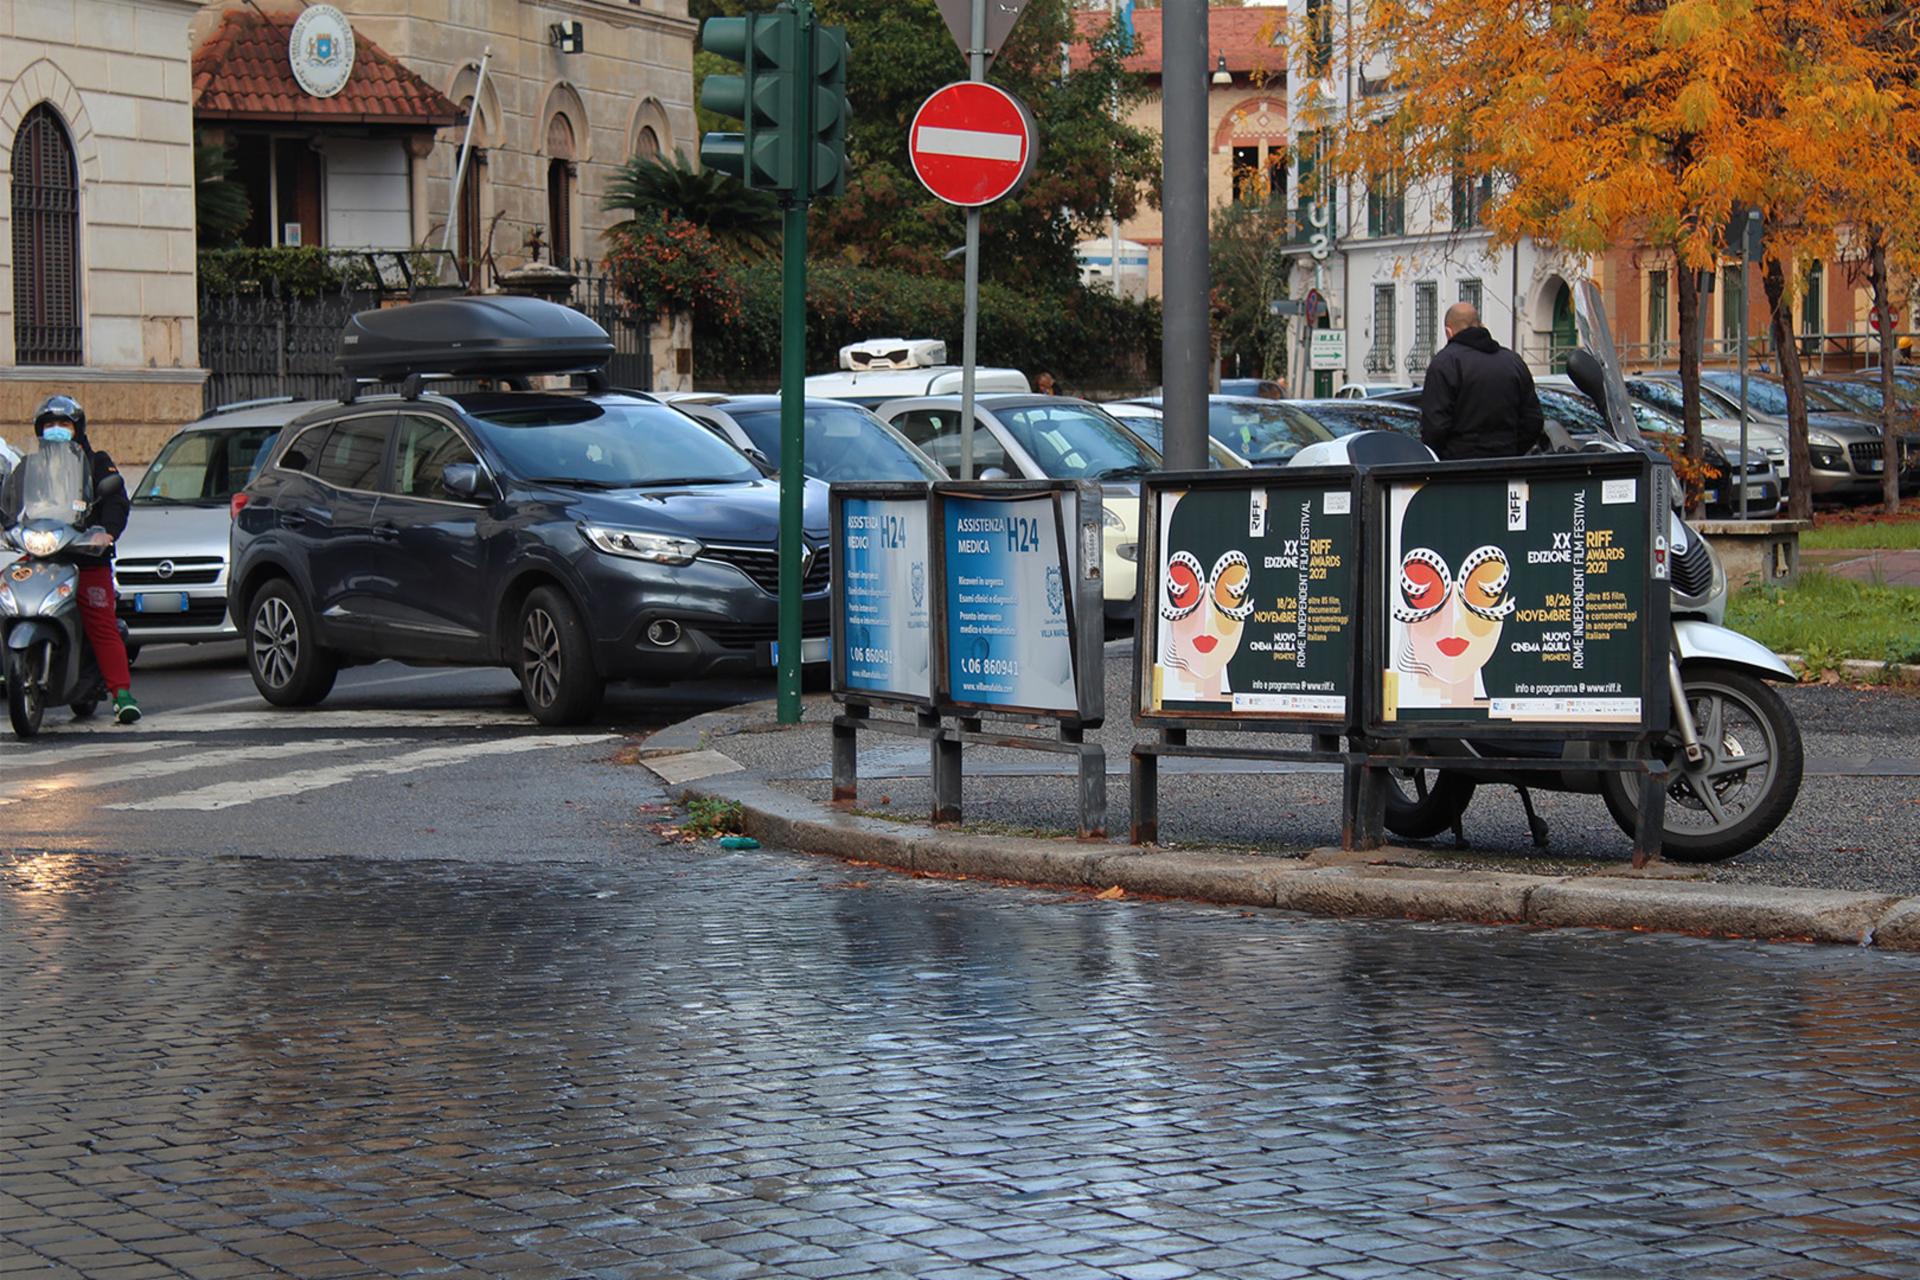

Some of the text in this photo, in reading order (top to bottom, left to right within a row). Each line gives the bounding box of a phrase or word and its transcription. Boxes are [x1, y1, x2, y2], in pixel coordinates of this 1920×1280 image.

[1510, 491, 1521, 523] RIFF
[1252, 500, 1260, 530] RIFF
[880, 515, 906, 549] H24
[957, 517, 1039, 552] ASSISTENZA H24
[1553, 532, 1571, 549] XX
[1586, 530, 1613, 548] RIFF
[958, 539, 990, 553] MEDICA
[1284, 540, 1299, 555] XX
[1310, 539, 1332, 555] RIFF
[1528, 551, 1572, 563] EDIZIONE
[1586, 548, 1625, 560] AWARDS
[1264, 556, 1299, 568] EDIZIONE
[1309, 555, 1341, 567] AWARDS
[1309, 568, 1327, 579] 2021
[1585, 562, 1608, 574] 2021
[1297, 500, 1311, 668] ROME INDEPENDENT FILM FESTIVAL
[1573, 489, 1585, 669] ROME INDEPENDENT FILM FESTIVAL
[1545, 594, 1571, 607] 18/26
[1602, 592, 1610, 600] 85
[1277, 598, 1297, 609] 18/26
[1586, 602, 1627, 610] documentari
[960, 612, 976, 621] Pronto
[1254, 612, 1297, 623] NOVEMBRE
[1516, 609, 1571, 622] NOVEMBRE
[1591, 611, 1637, 622] cortometraggi
[1594, 622, 1627, 631] anteprima
[1273, 633, 1296, 642] NUOVO
[1542, 632, 1571, 641] NUOVO
[1585, 632, 1610, 640] italiana
[1250, 641, 1296, 651] CINEMA AQUILA
[1511, 642, 1571, 652] CINEMA AQUILA
[854, 647, 864, 662] 06
[968, 658, 1019, 676] 06 860941
[1252, 680, 1263, 689] info
[1268, 682, 1300, 691] programma
[1307, 681, 1335, 691] www.riff.it
[1515, 683, 1529, 693] info
[1536, 684, 1578, 695] programma
[1579, 683, 1586, 693] @
[1586, 683, 1622, 693] www.riff.it
